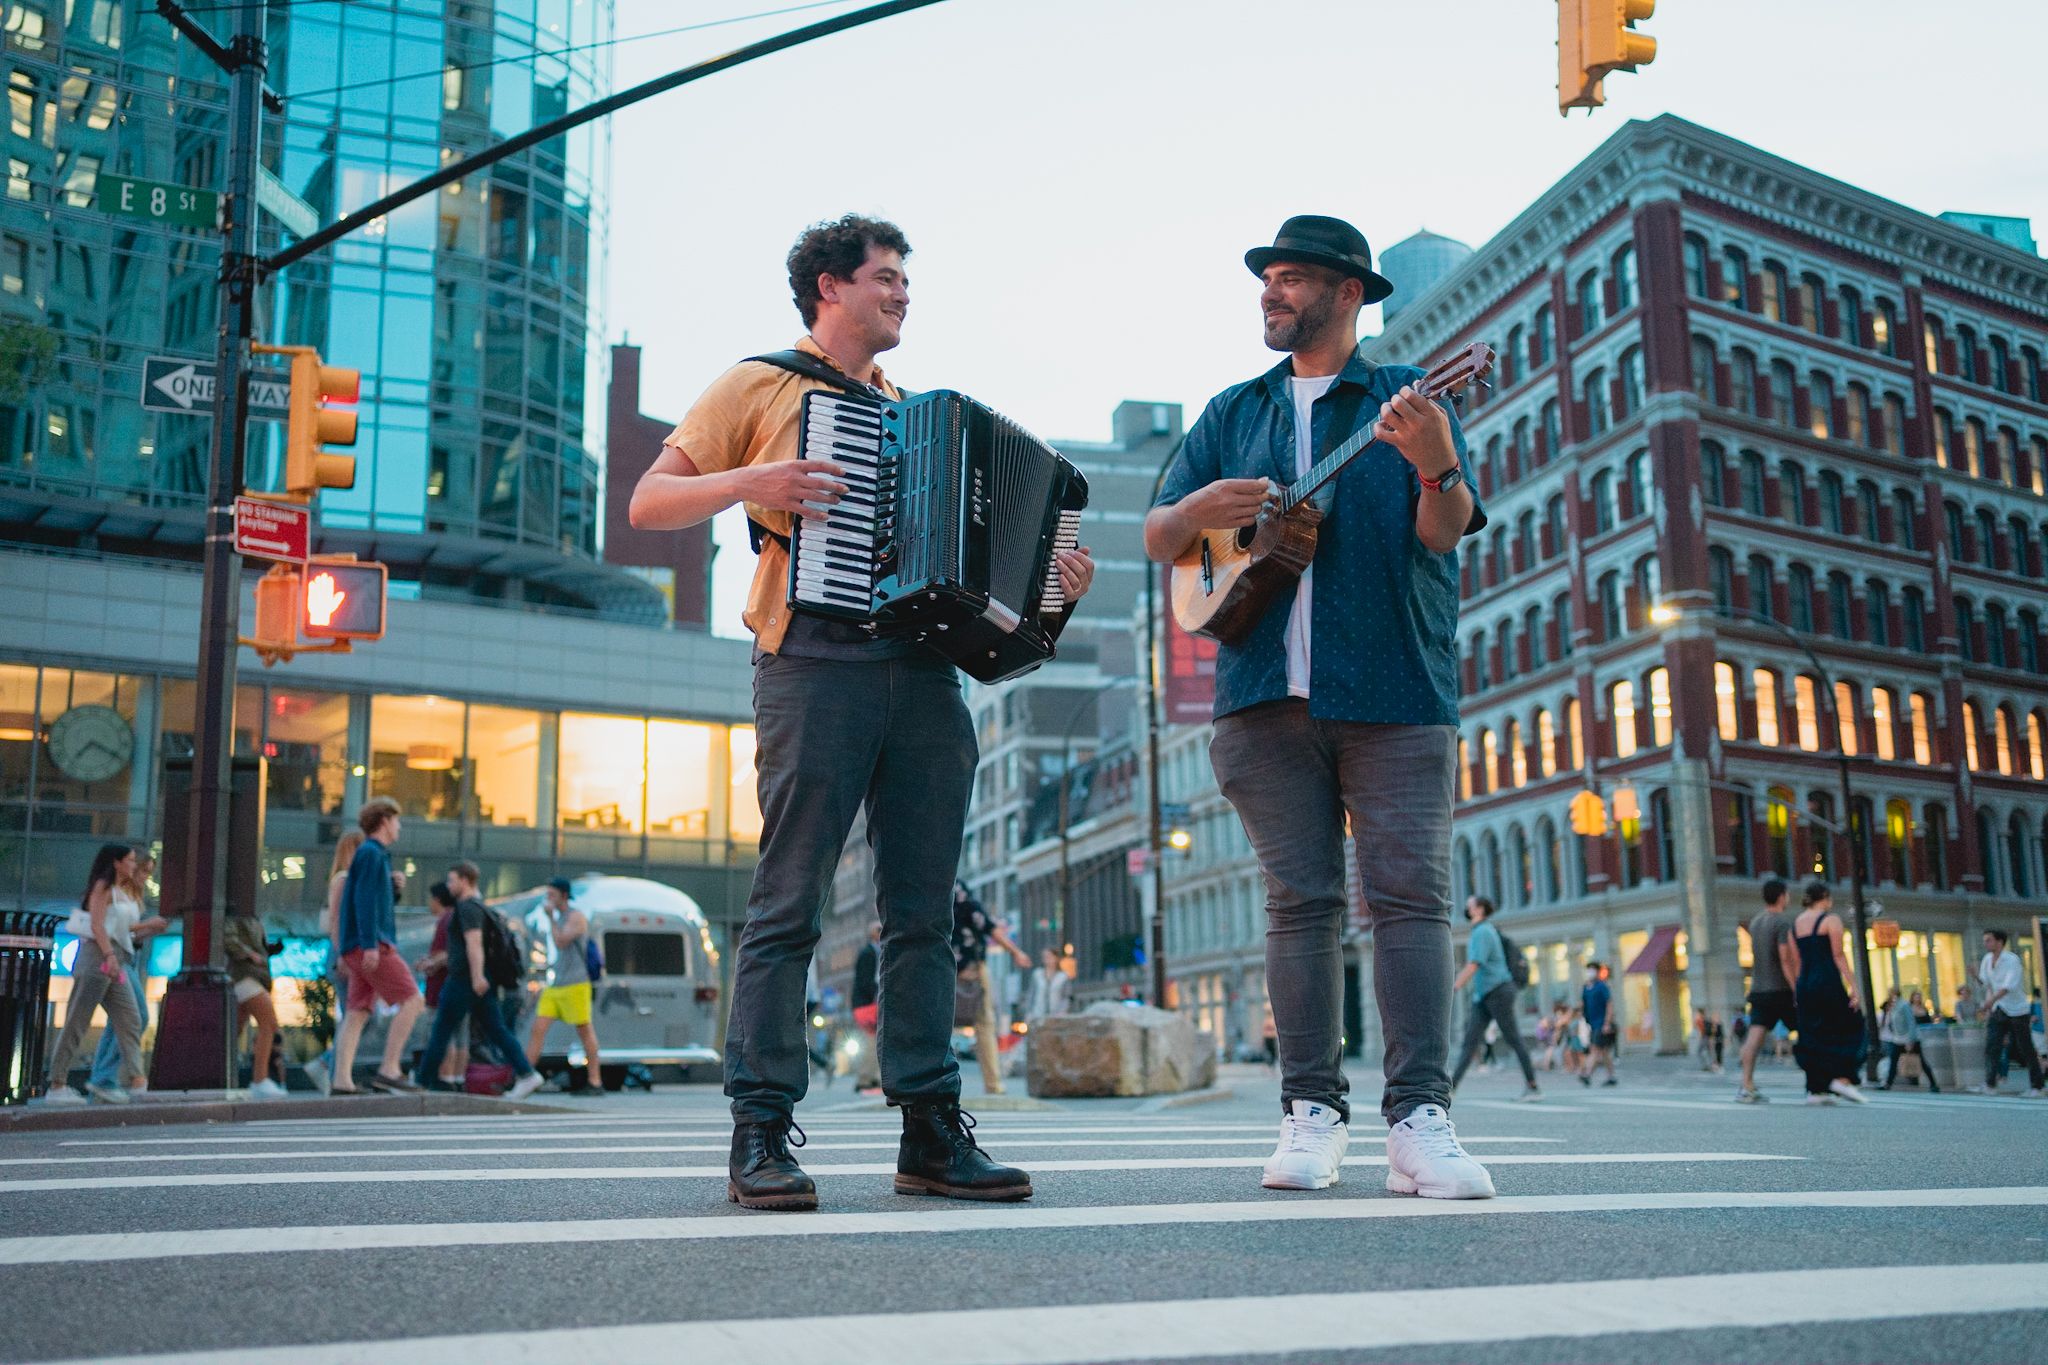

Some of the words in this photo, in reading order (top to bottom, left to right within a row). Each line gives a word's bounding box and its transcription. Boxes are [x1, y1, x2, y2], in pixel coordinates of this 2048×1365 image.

[121, 182, 135, 211] E
[150, 187, 167, 216] 8
[179, 192, 198, 211] St
[172, 376, 217, 398] ONE
[972, 467, 986, 526] petosa
[240, 503, 254, 516] NO
[255, 505, 299, 525] STANDING
